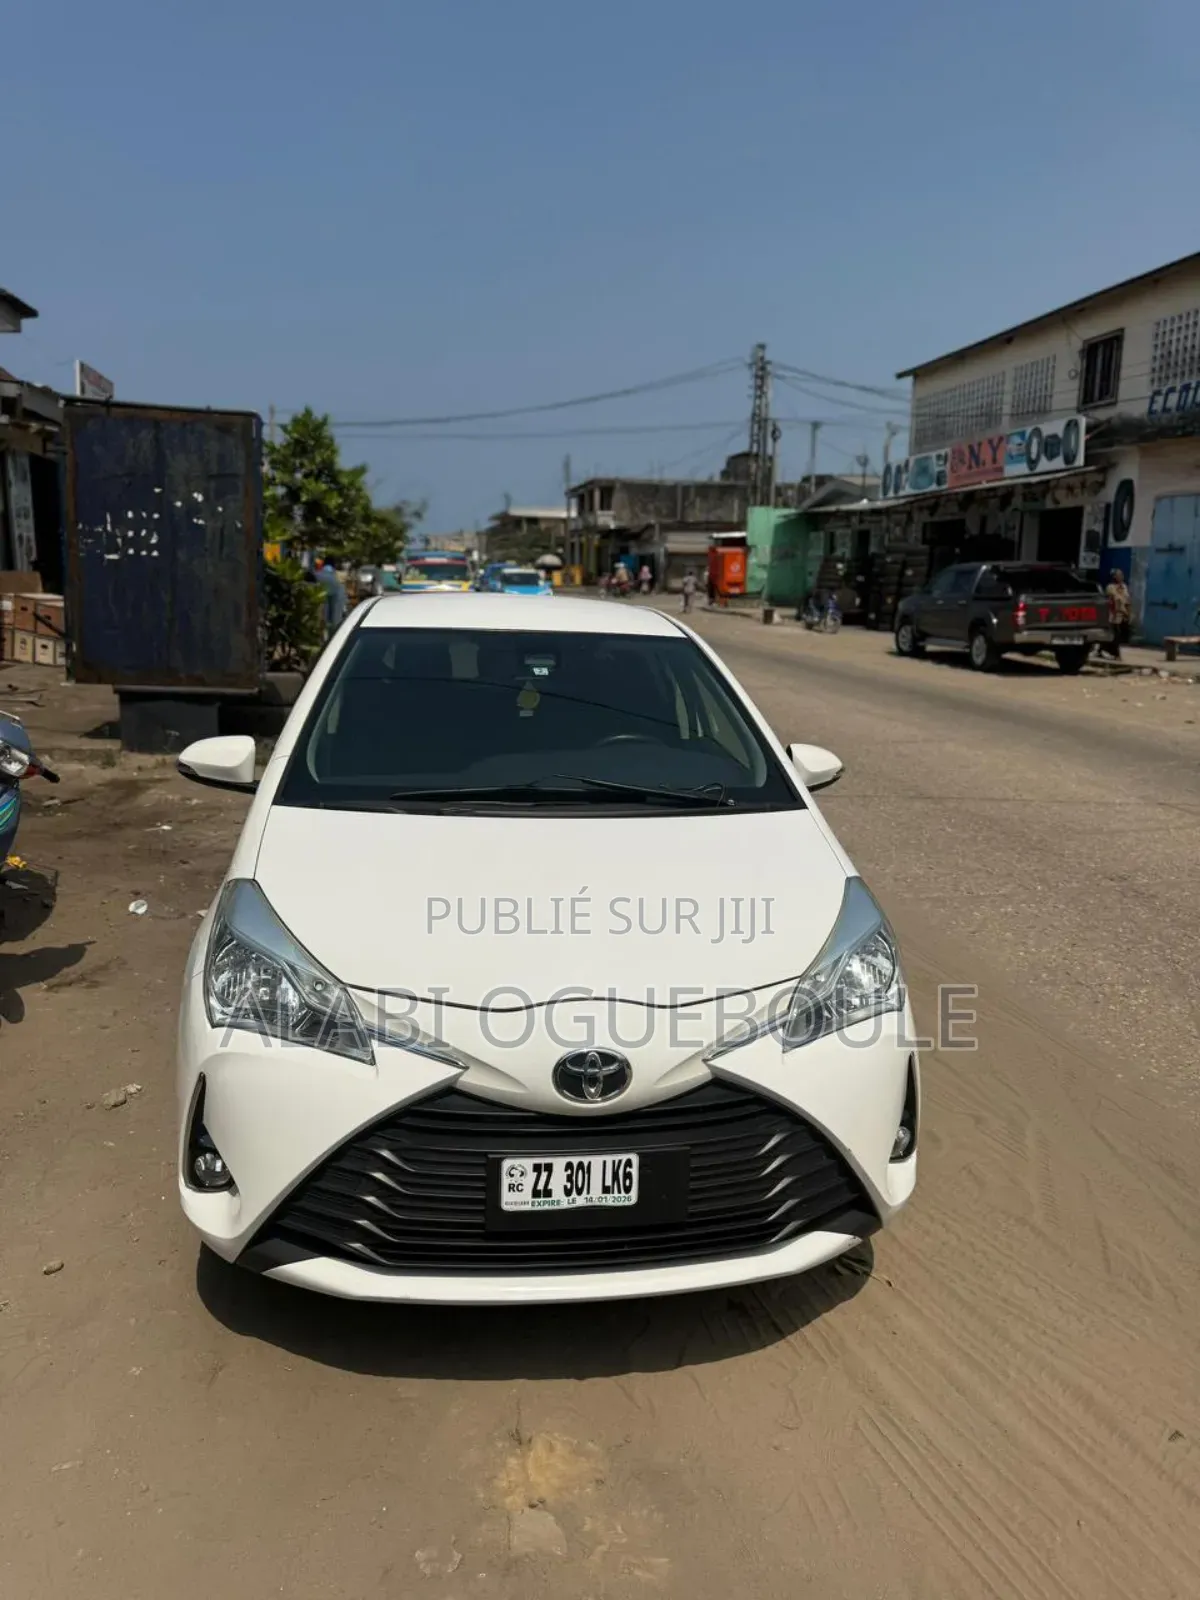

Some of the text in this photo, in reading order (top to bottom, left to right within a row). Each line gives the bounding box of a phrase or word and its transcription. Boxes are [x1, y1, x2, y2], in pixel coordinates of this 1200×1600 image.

[508, 1183, 524, 1193] RC
[531, 1158, 633, 1199] ZZ 301 LK6
